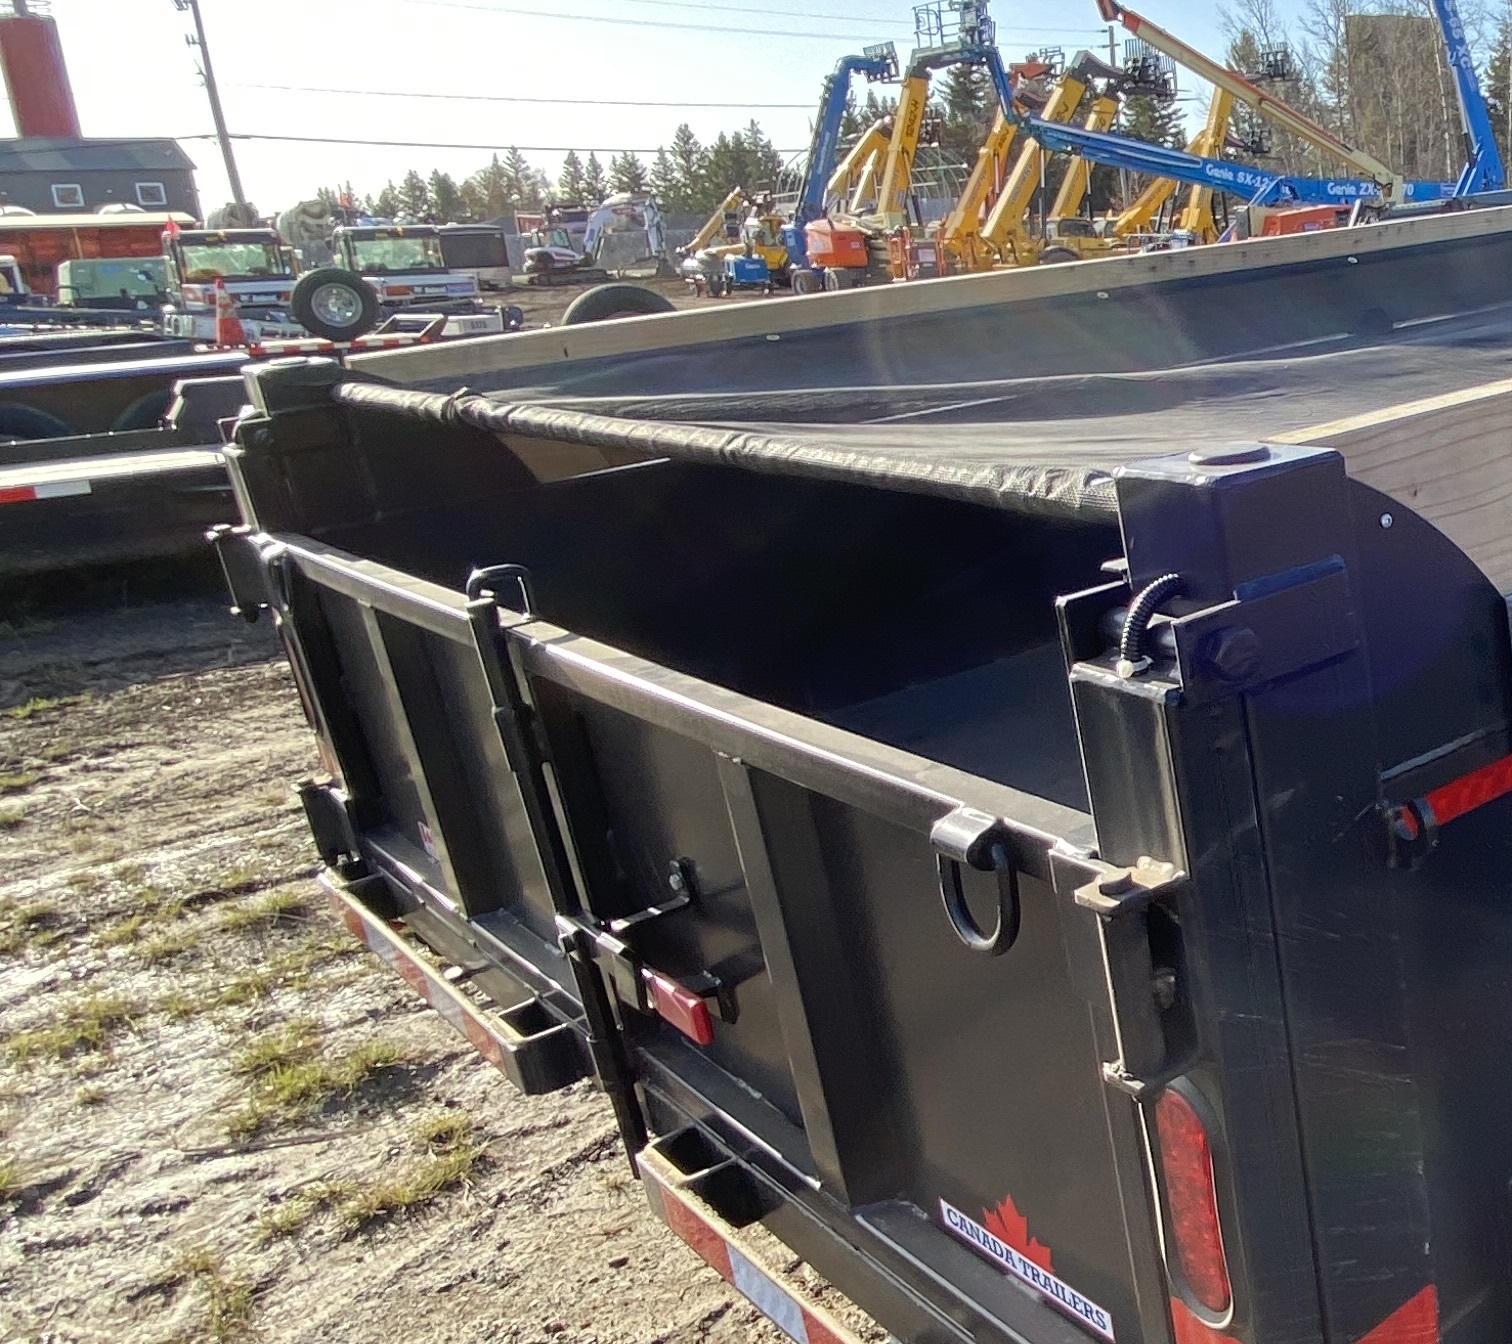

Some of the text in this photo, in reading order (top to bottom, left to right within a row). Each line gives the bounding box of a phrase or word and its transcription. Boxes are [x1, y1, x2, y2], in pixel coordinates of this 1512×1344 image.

[1206, 163, 1234, 181] Genie
[1327, 182, 1357, 196] Genie
[947, 1208, 1107, 1330] CANADA TRAILERS
